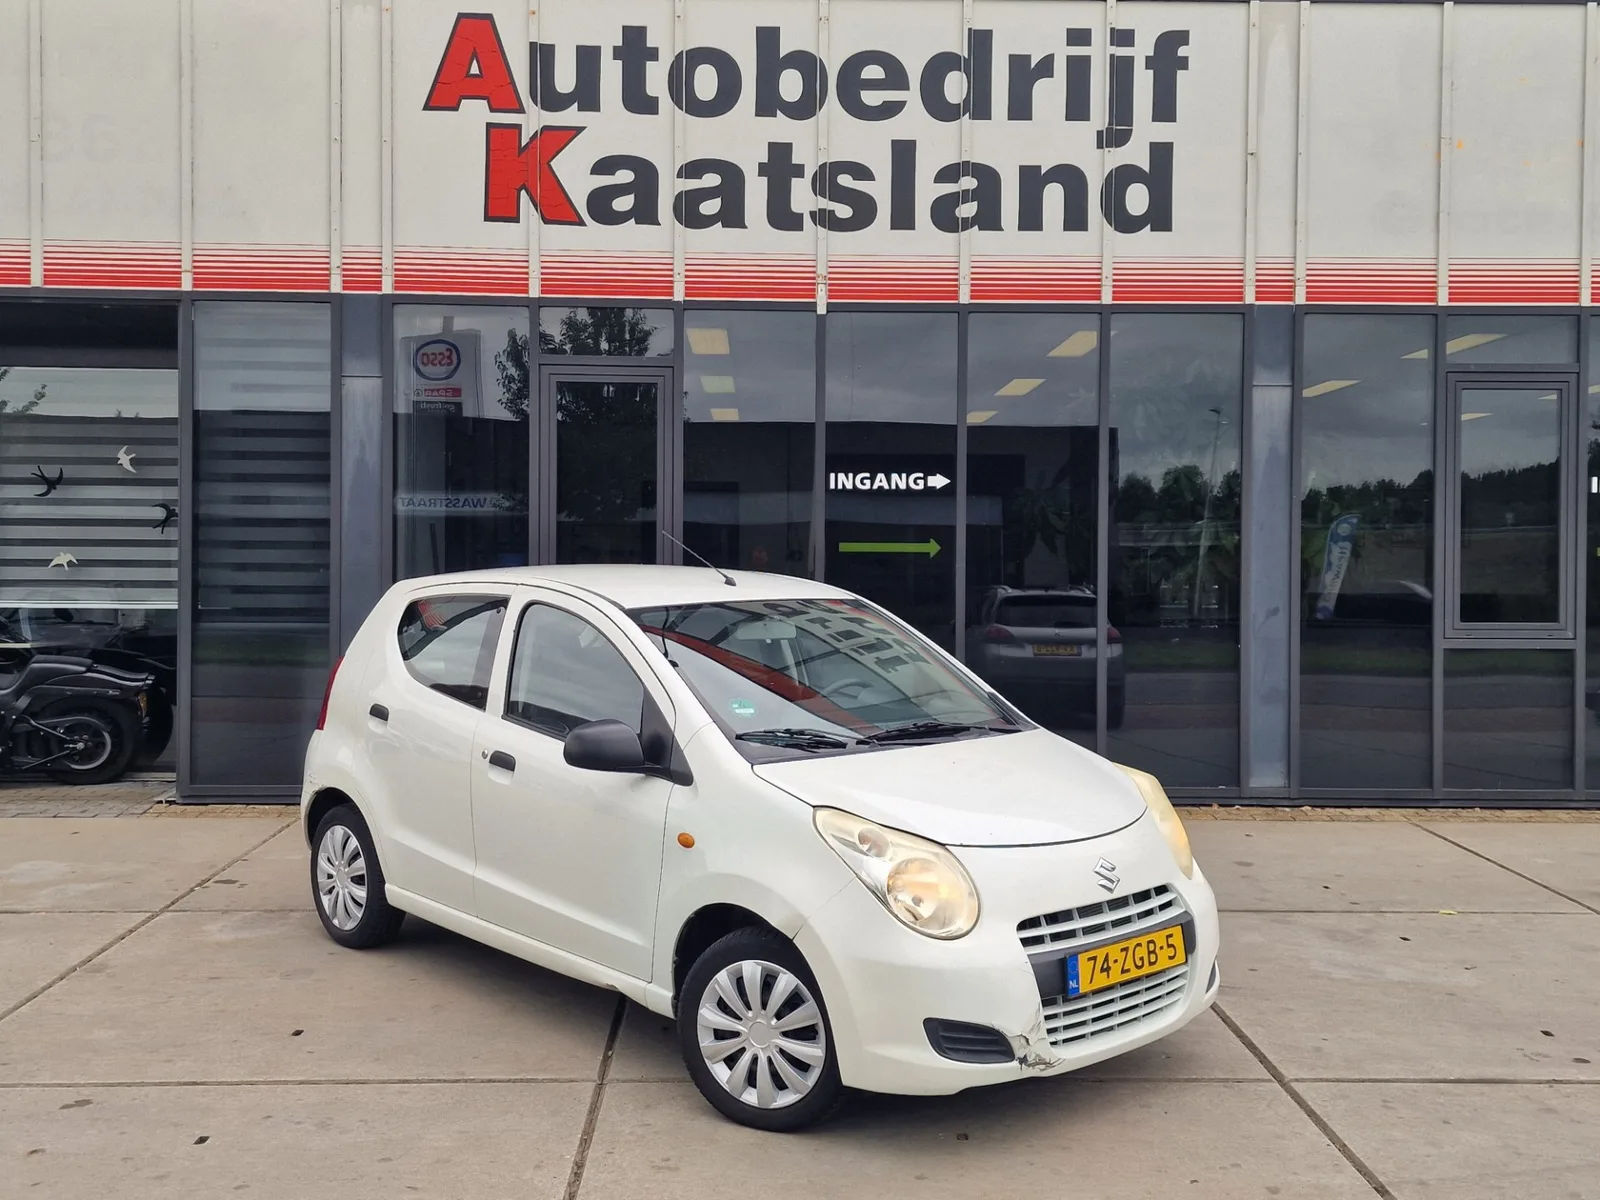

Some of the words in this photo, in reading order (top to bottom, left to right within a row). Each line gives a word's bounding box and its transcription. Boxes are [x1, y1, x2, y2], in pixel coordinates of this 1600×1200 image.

[422, 12, 1190, 149] Autobedrijf
[484, 122, 1174, 234] Kaatsland
[829, 472, 925, 490] INGANG
[1069, 980, 1079, 989] NL
[1086, 933, 1178, 985] 74-ZGB-5
